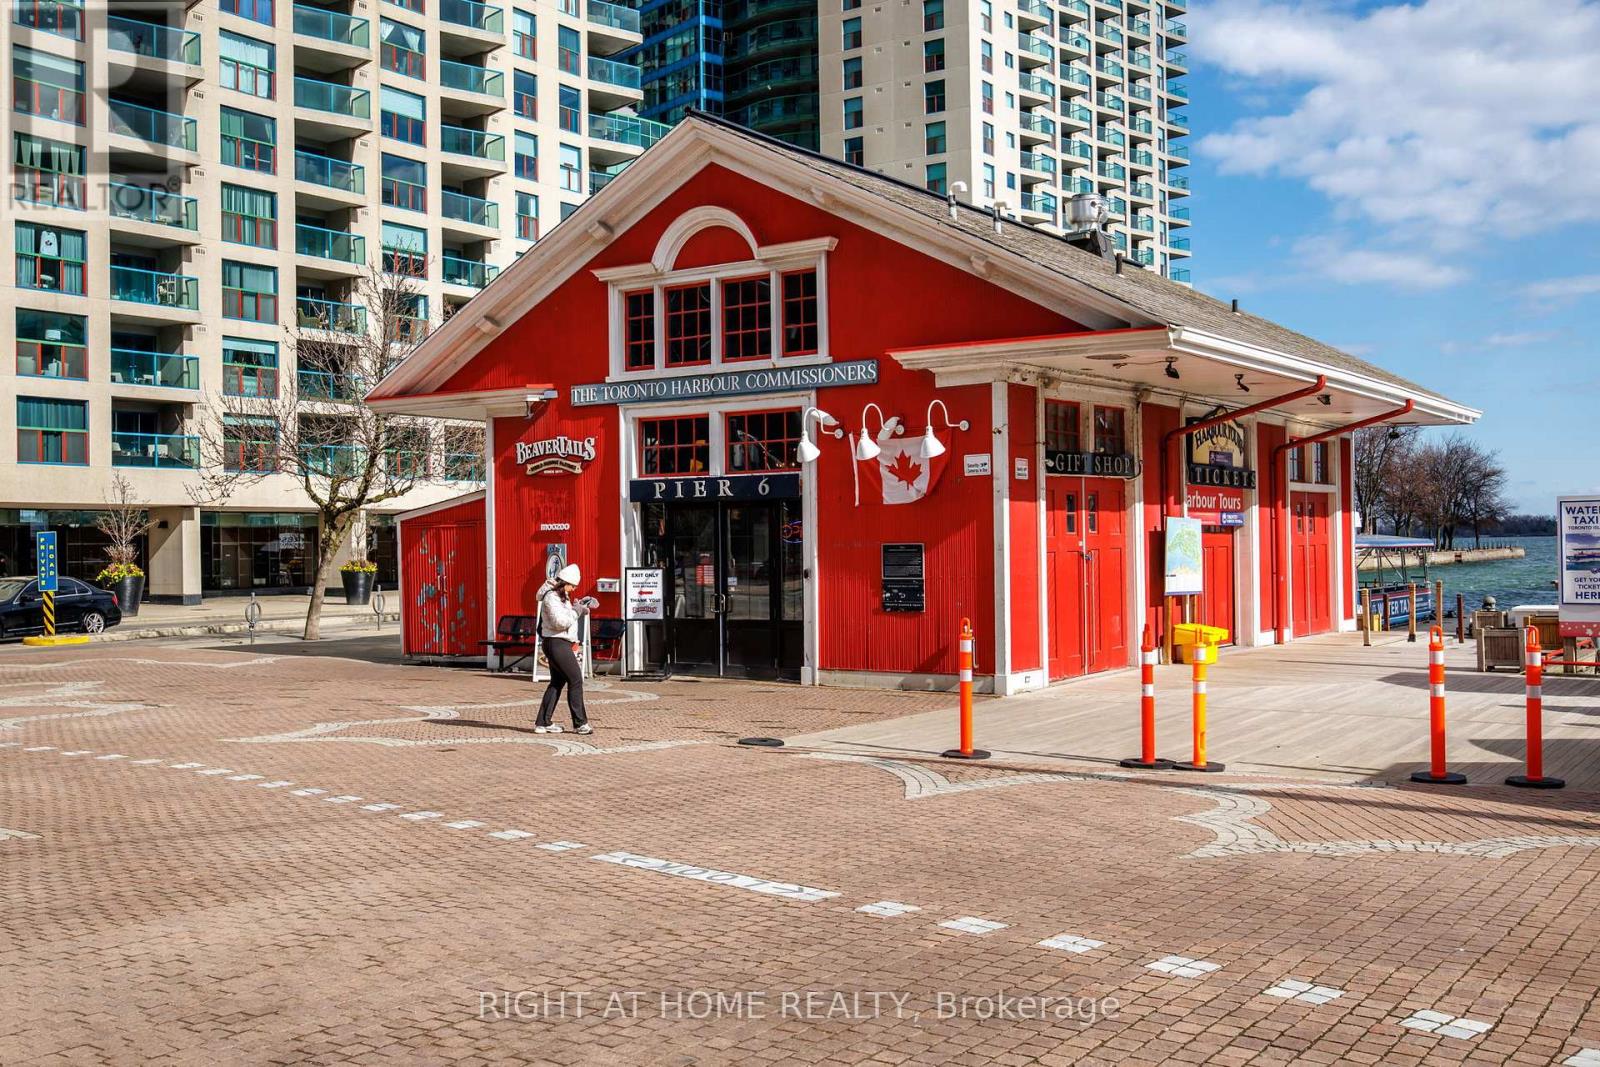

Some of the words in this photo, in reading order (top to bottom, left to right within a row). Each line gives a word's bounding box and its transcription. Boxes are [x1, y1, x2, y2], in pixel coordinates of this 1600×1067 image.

[572, 387, 598, 403] THE
[601, 381, 667, 401] TORONTO
[671, 376, 740, 396] HARBOUR
[745, 363, 877, 390] COMMISSIONERS
[1055, 453, 1088, 472] GIFT
[1094, 456, 1130, 474] SHOP
[1194, 467, 1256, 487] TICKETS
[653, 480, 734, 499] PIER
[758, 477, 770, 496] 6
[1187, 490, 1217, 509] arbour
[1218, 493, 1241, 510] Tours
[1565, 505, 1600, 515] WATE
[1572, 515, 1599, 525] TAXI
[1377, 599, 1399, 616] WTER
